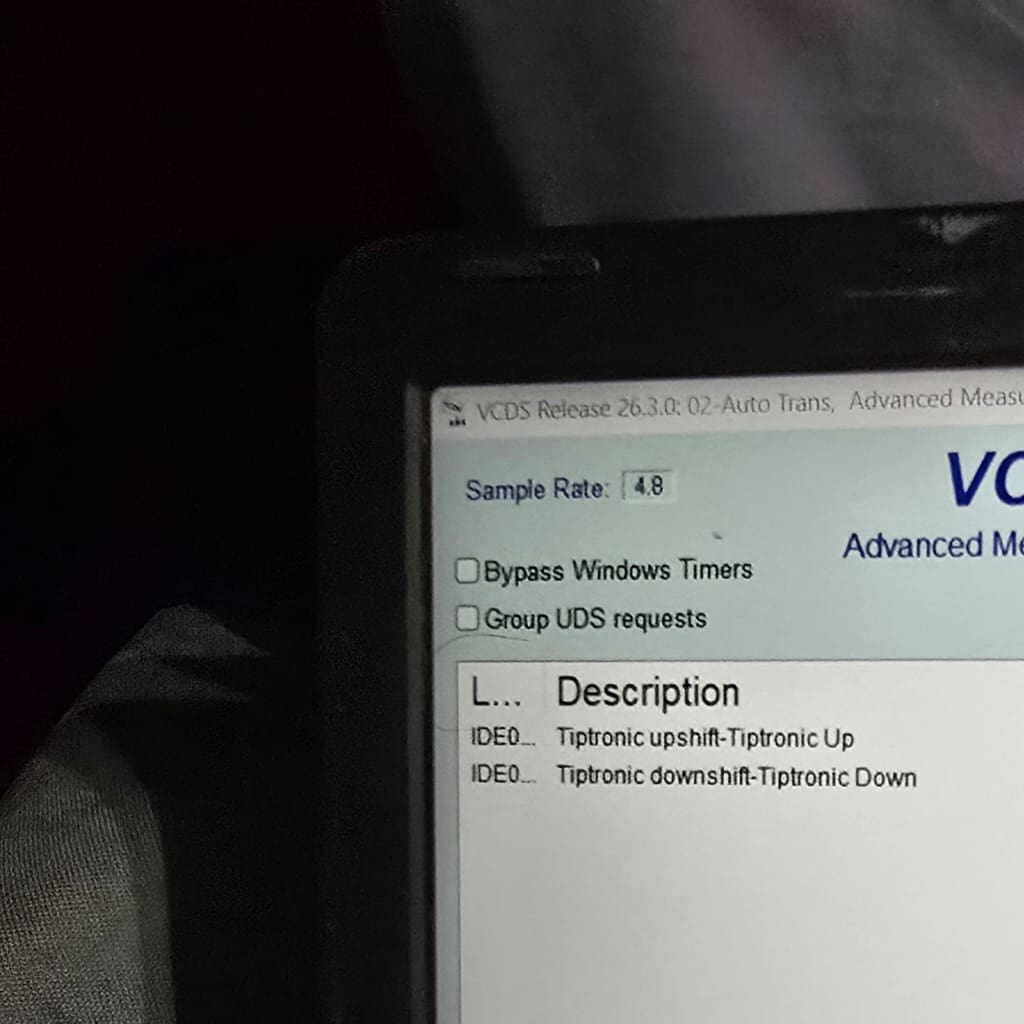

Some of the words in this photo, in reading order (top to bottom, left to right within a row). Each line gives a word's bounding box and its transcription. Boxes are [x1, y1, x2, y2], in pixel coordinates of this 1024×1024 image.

[476, 402, 531, 421] VCDS
[538, 399, 611, 419] Release
[687, 393, 770, 415] 02-Auto
[778, 391, 834, 414] Trans,
[848, 388, 952, 409] Advanced
[466, 479, 545, 505] Sample
[634, 475, 664, 497] 4.8
[843, 530, 983, 560] Advanced
[484, 561, 564, 586] Bypass
[572, 559, 670, 581] Windows
[679, 558, 753, 582] Timers
[484, 607, 549, 634] Group
[556, 607, 606, 630] UDS
[613, 607, 708, 633] requests
[557, 675, 740, 714] Description
[557, 727, 645, 754] Tiptronic
[650, 728, 819, 756] upshift-Tiptronic
[824, 729, 855, 753] Up
[557, 764, 645, 790] Tiptronic
[649, 764, 850, 793] downshift-Tiptronic
[855, 768, 918, 790] Down
